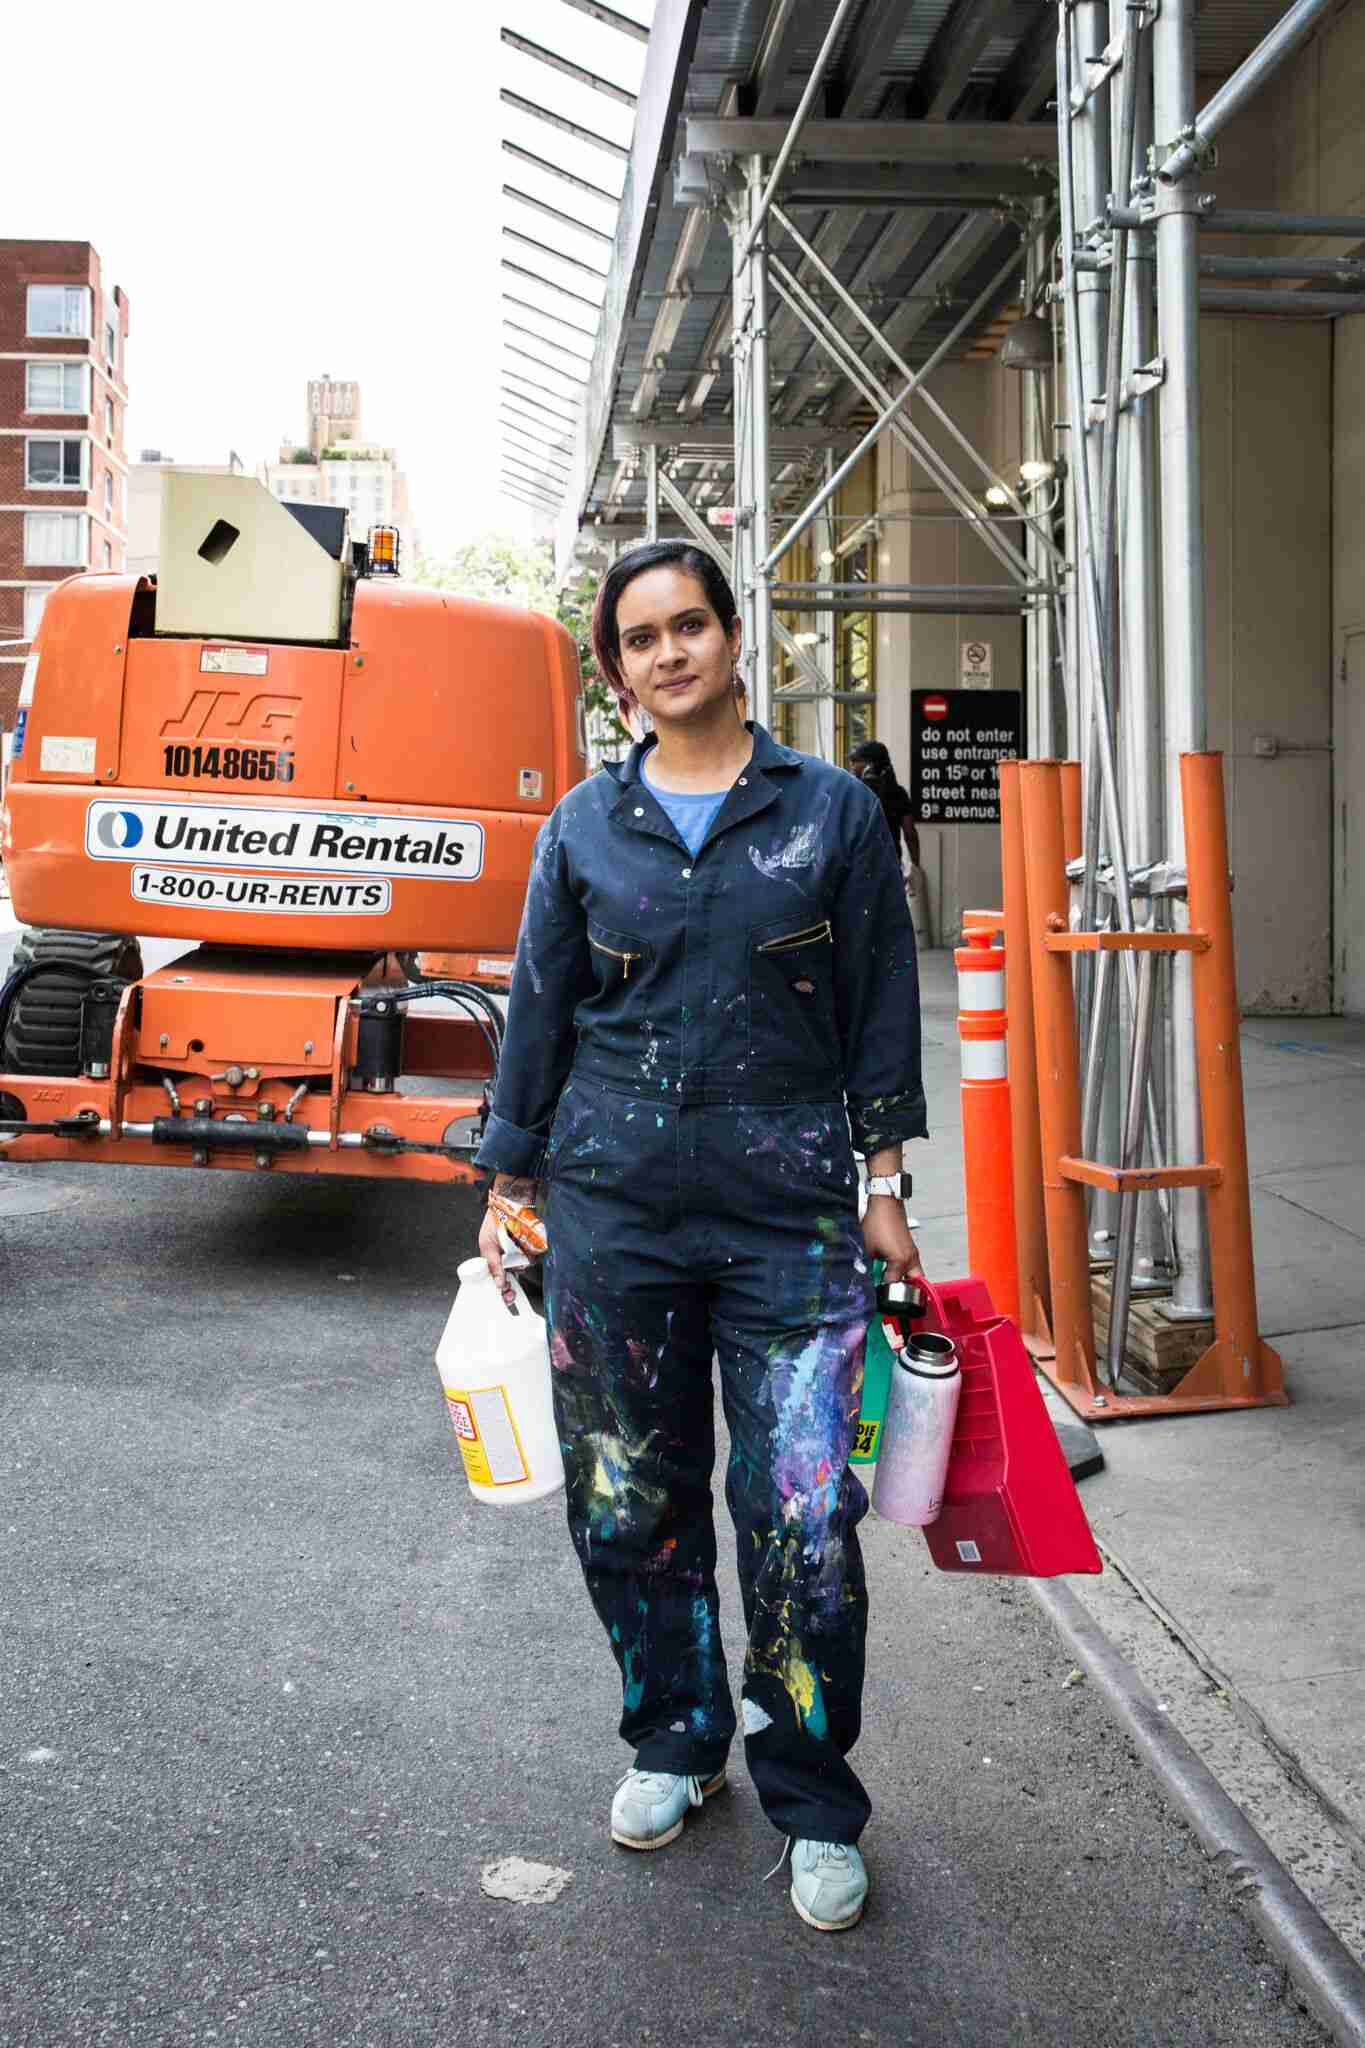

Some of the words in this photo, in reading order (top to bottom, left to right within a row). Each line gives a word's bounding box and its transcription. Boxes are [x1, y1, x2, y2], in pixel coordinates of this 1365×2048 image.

[159, 689, 302, 743] JLG
[921, 726, 941, 742] do
[946, 728, 970, 742] not
[976, 728, 1015, 742] enter
[921, 747, 948, 760] use
[954, 745, 1017, 760] entrance
[164, 745, 295, 782] 10148655
[921, 767, 940, 780] on
[970, 767, 986, 780] or
[921, 784, 965, 800] street
[944, 805, 1000, 819] avenue.
[154, 815, 301, 857] United
[309, 824, 465, 867] Rentals
[139, 873, 383, 906] 1-800-UR-RENTS
